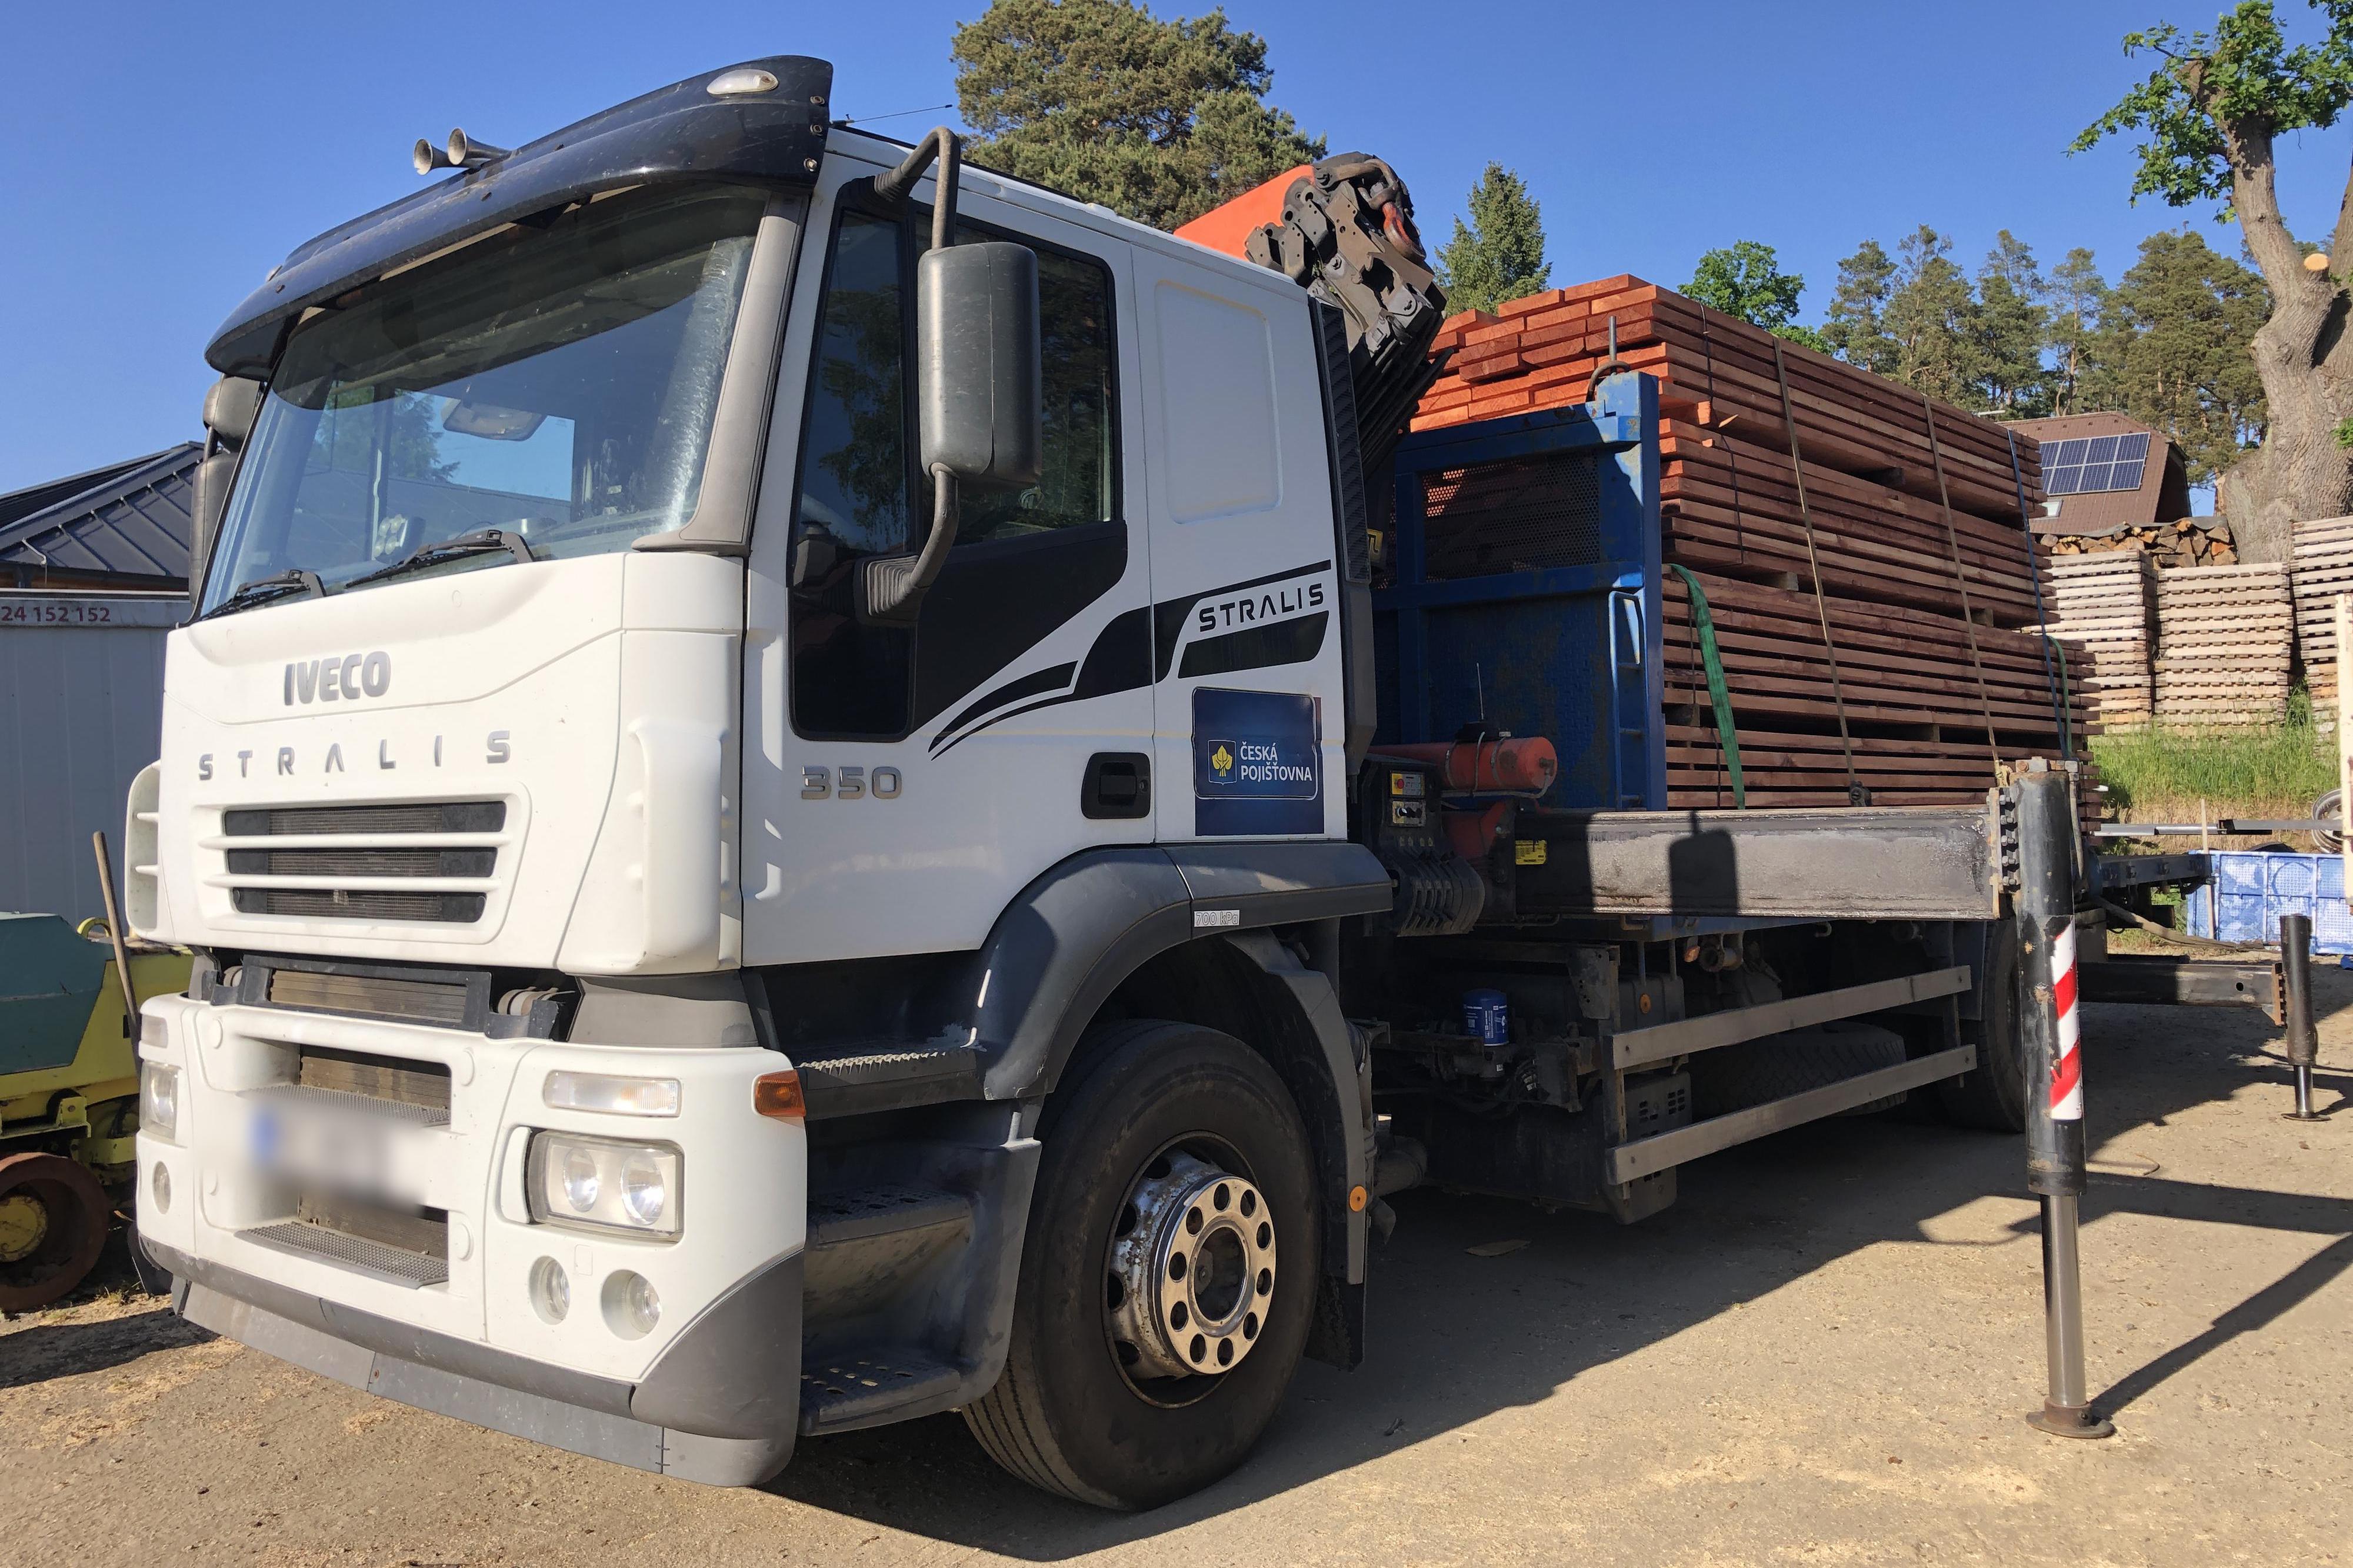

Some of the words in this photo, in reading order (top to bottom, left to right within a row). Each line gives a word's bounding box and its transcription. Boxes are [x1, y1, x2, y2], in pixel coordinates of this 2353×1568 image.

[34, 607, 68, 622] 152
[76, 607, 111, 622] 152
[1199, 583, 1325, 632] STRALIS
[284, 650, 391, 706] IVECO
[198, 730, 511, 781] STRALIS
[1239, 741, 1278, 761] ČESKÁ
[801, 766, 902, 800] 350
[1240, 760, 1312, 782] POJIŠŤOVNA
[1196, 912, 1217, 926] 700
[1219, 911, 1238, 925] kPa
